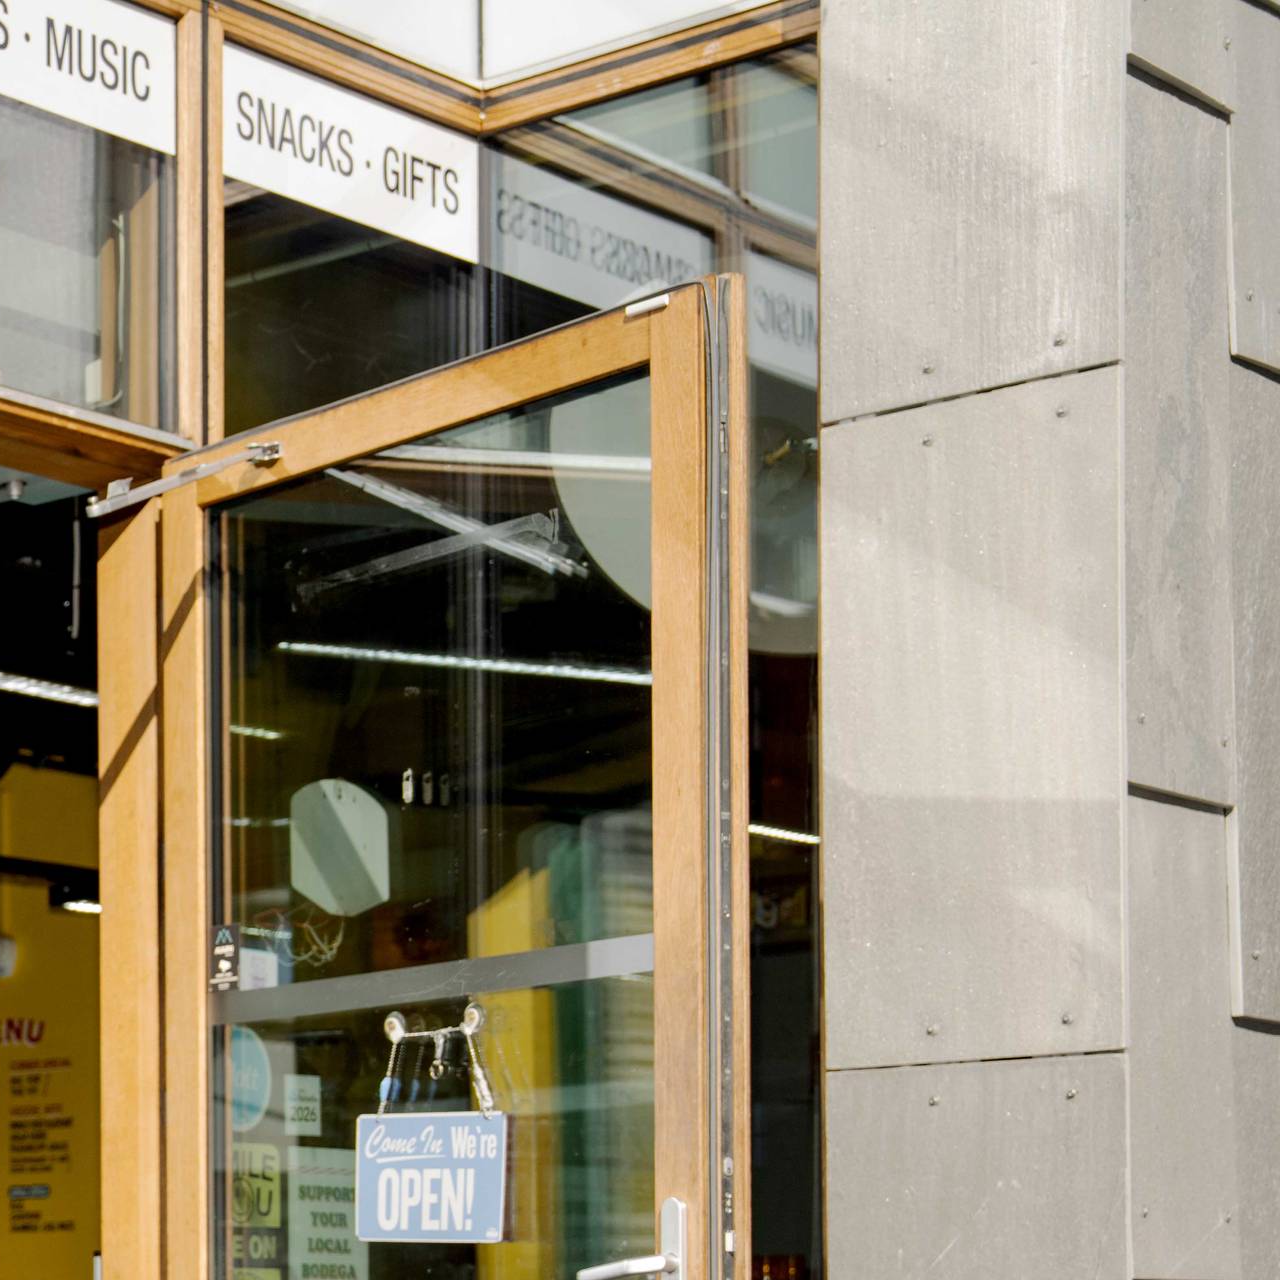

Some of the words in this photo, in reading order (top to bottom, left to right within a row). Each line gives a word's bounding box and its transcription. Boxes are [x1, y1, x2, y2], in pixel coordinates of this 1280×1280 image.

[45, 17, 151, 102] MUSIC
[236, 91, 354, 177] SNACKS
[383, 146, 460, 215] GIFTS
[365, 1125, 417, 1160] Come
[419, 1126, 445, 1155] In
[451, 1126, 498, 1160] We're
[377, 1168, 474, 1232] OPEN!
[310, 1211, 348, 1228] YOUR
[249, 1235, 277, 1259] ON
[307, 1238, 351, 1255] LOCAL
[301, 1263, 358, 1280] BODEGA
